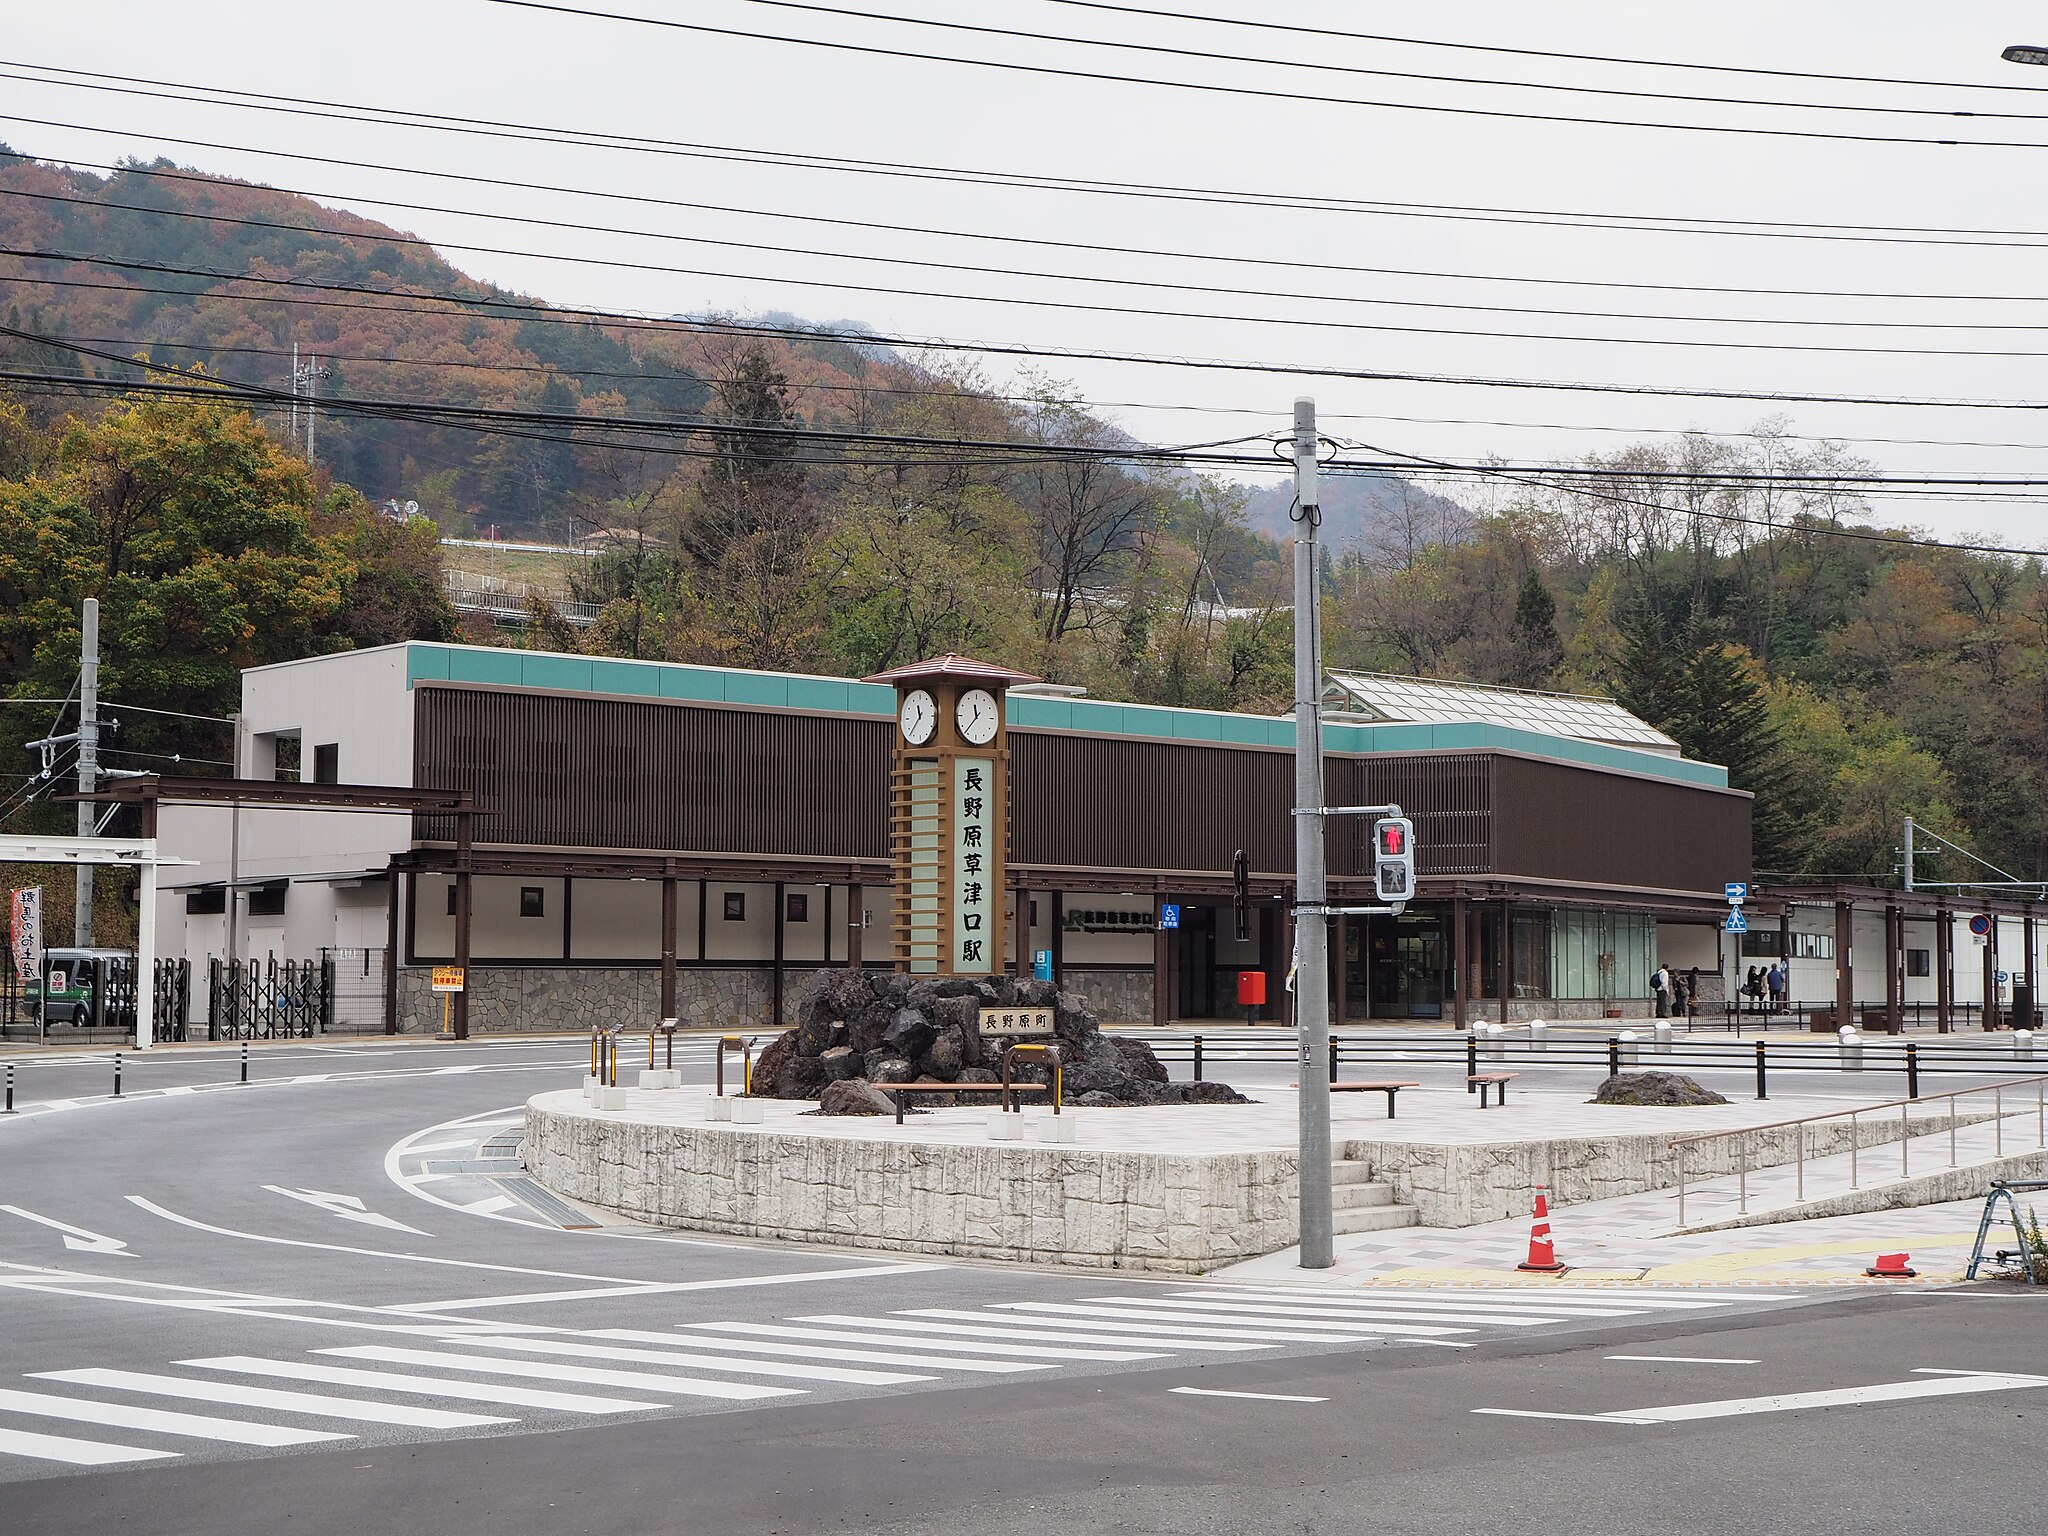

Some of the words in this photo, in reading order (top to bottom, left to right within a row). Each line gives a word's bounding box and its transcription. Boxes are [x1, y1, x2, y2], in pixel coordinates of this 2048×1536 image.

[963, 767, 983, 962] 長野原草津口駅
[985, 1013, 1047, 1029] 長野原町
